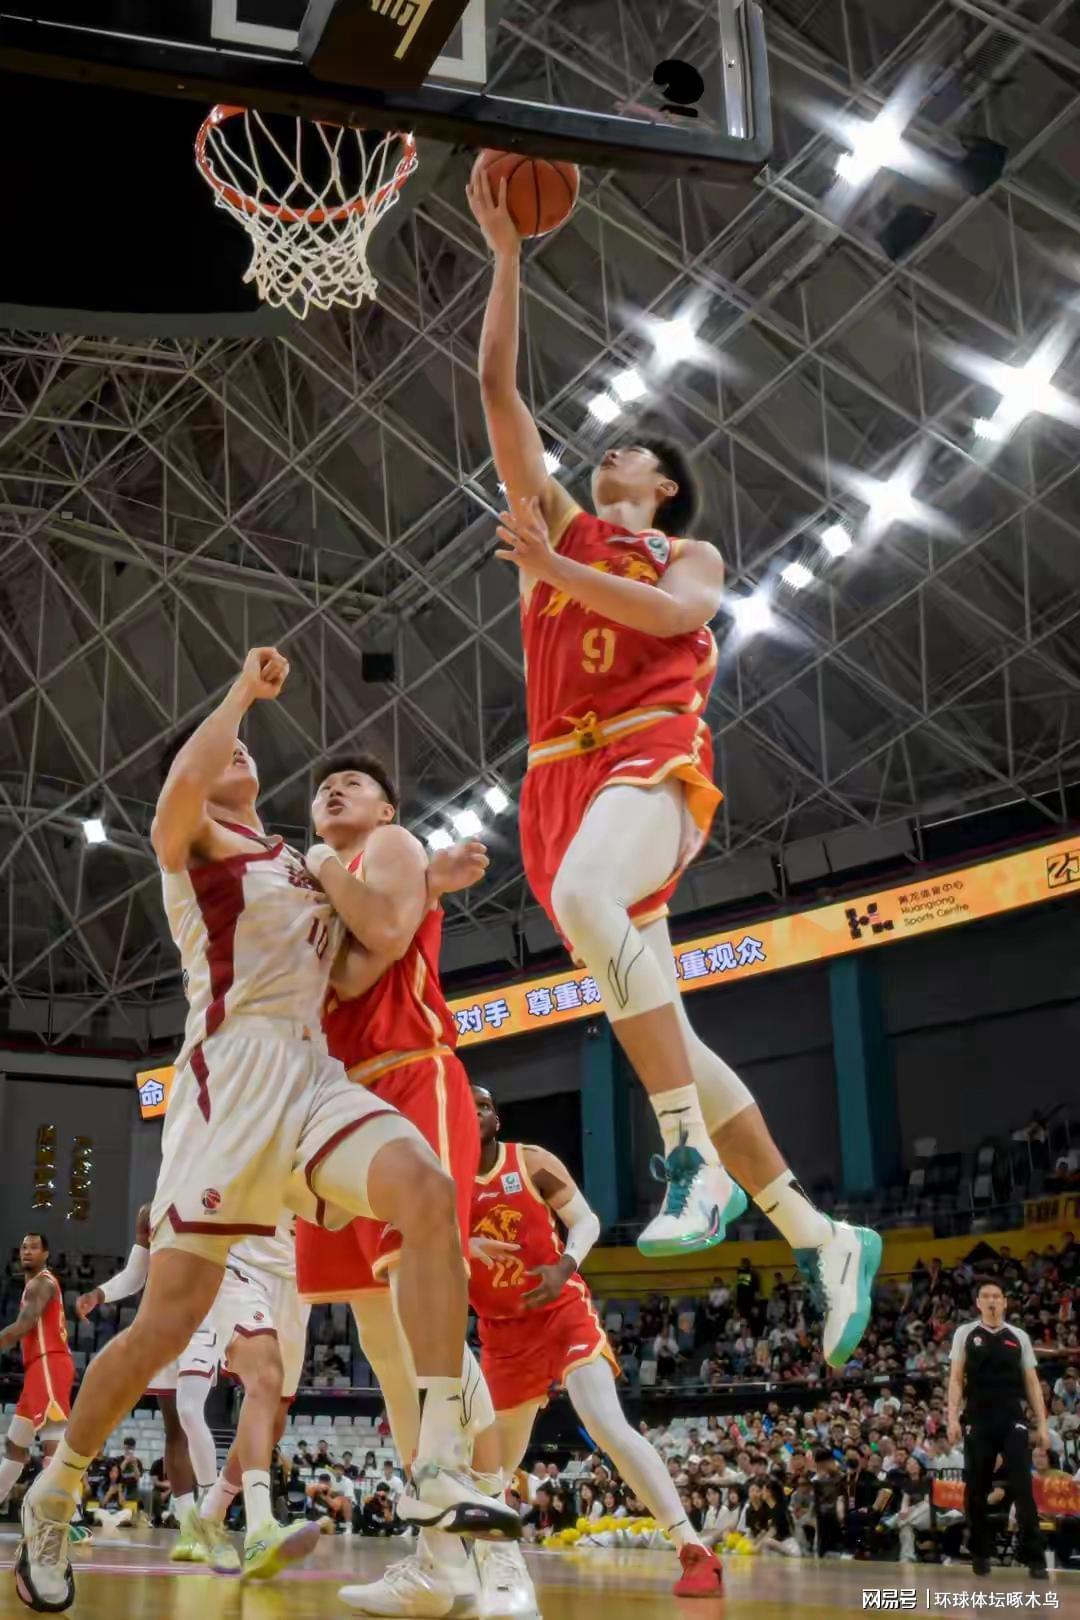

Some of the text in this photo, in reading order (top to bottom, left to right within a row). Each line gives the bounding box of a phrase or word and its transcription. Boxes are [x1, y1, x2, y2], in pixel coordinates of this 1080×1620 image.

[582, 628, 616, 673] 9
[903, 911, 935, 927] Sports
[453, 1000, 511, 1034] 对手
[137, 1079, 165, 1106] 命
[492, 1254, 524, 1287] 22
